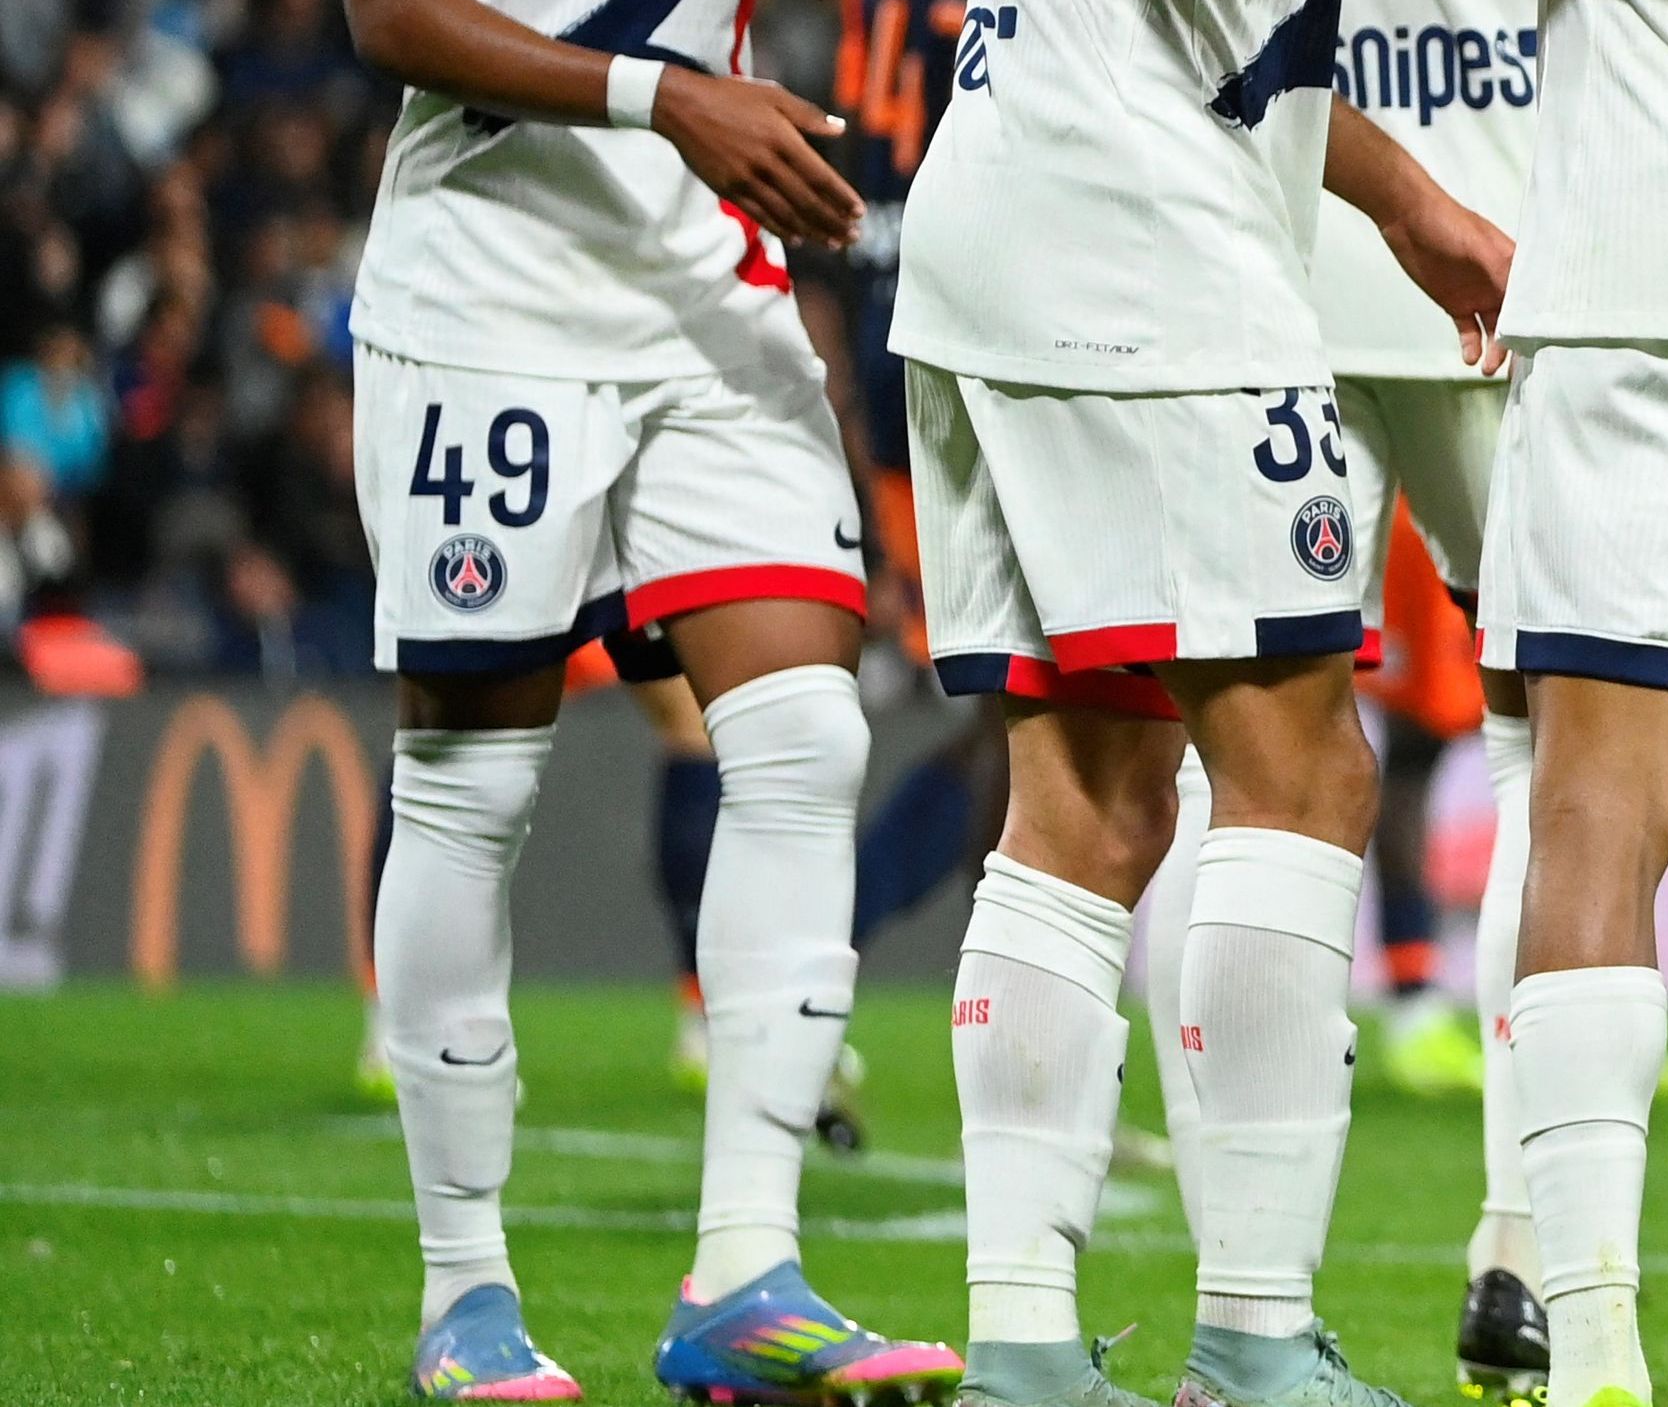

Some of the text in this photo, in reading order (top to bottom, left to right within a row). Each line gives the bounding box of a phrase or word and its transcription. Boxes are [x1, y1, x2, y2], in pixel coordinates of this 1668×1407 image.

[410, 403, 550, 529] 49
[1301, 500, 1342, 525] PARIS
[953, 997, 990, 1027] ARIS
